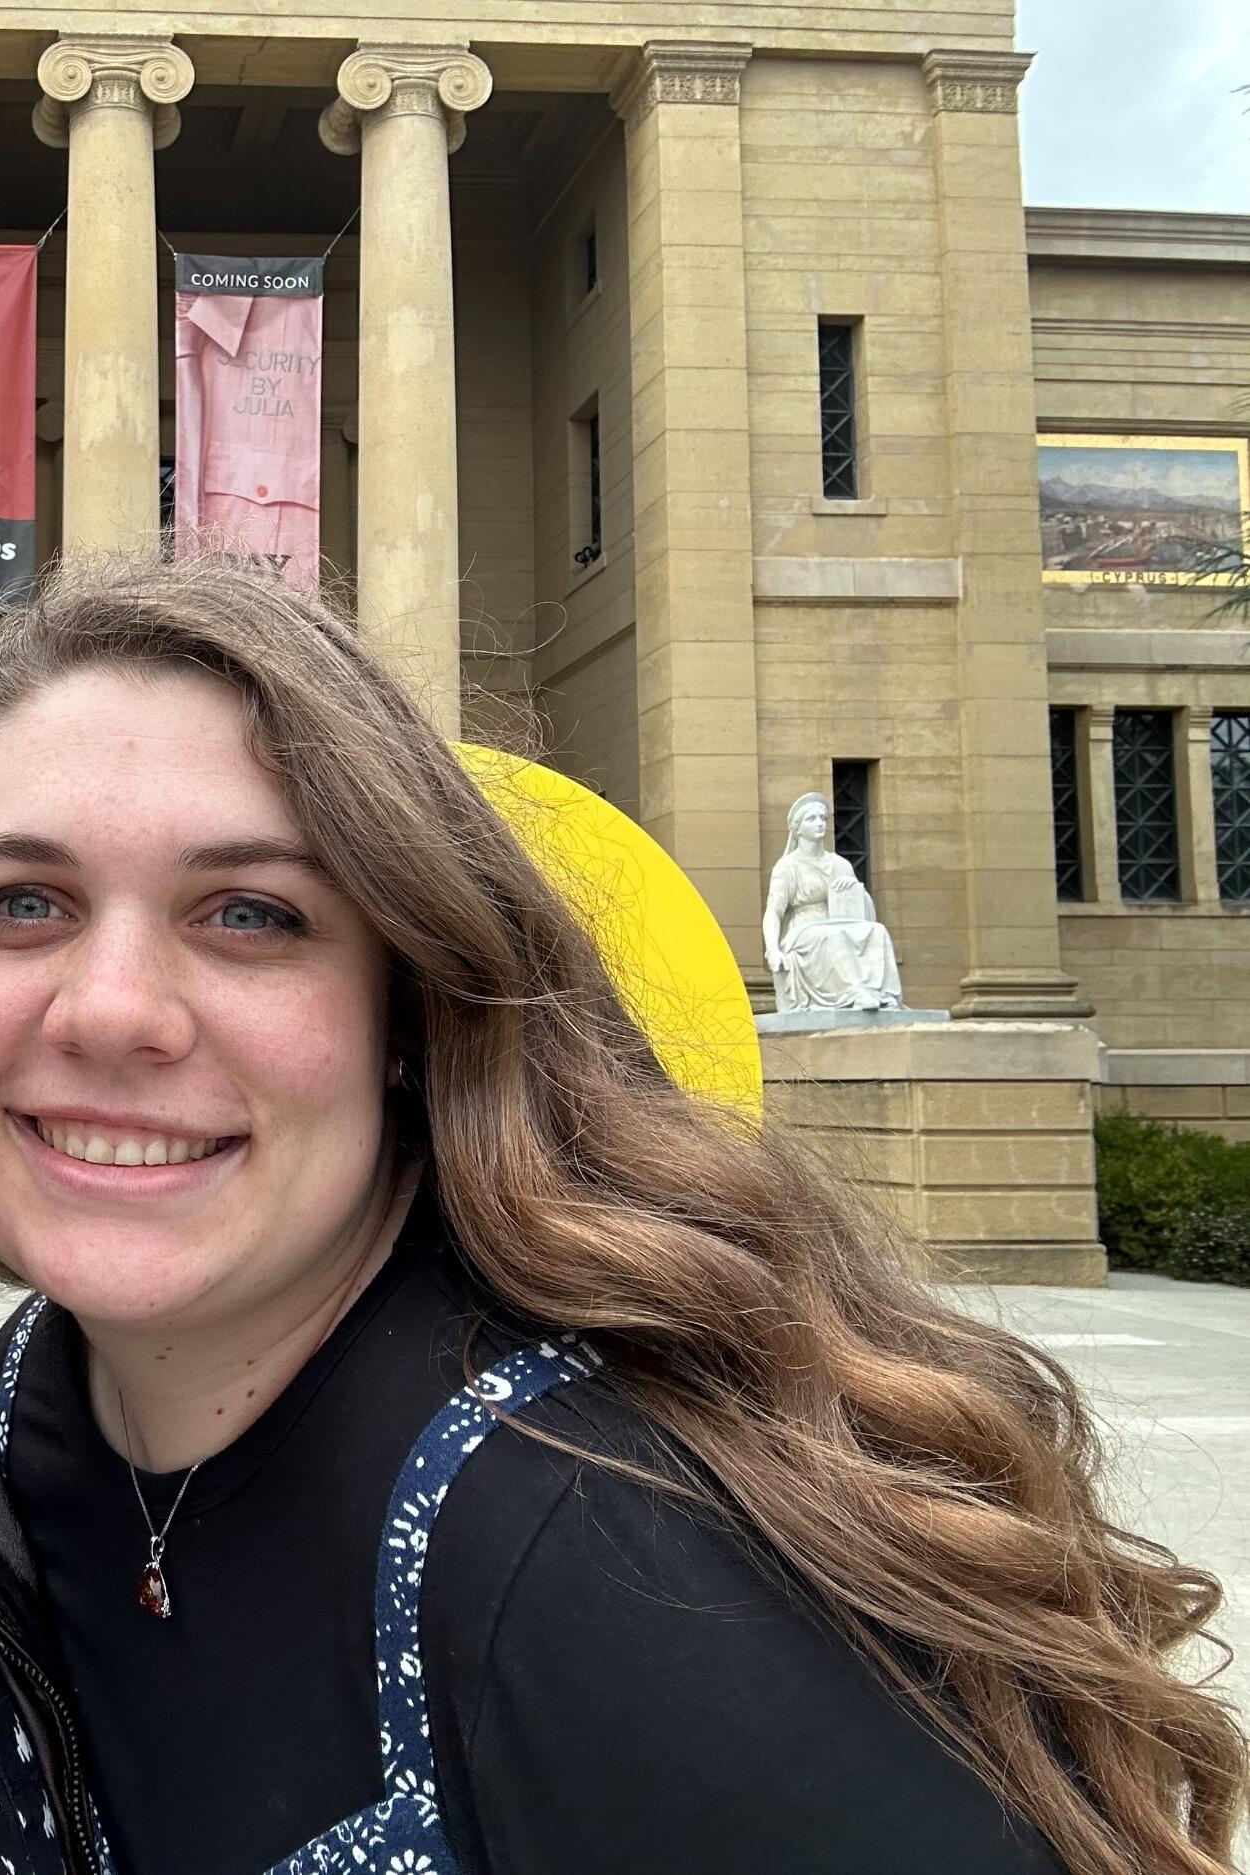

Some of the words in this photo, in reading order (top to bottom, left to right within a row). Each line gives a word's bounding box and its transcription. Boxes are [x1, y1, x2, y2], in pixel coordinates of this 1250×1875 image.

[191, 273, 259, 288] COMING
[263, 275, 309, 289] SOON
[253, 377, 282, 396] BY
[233, 398, 294, 417] JULIA
[1102, 572, 1167, 583] CYPRUS
